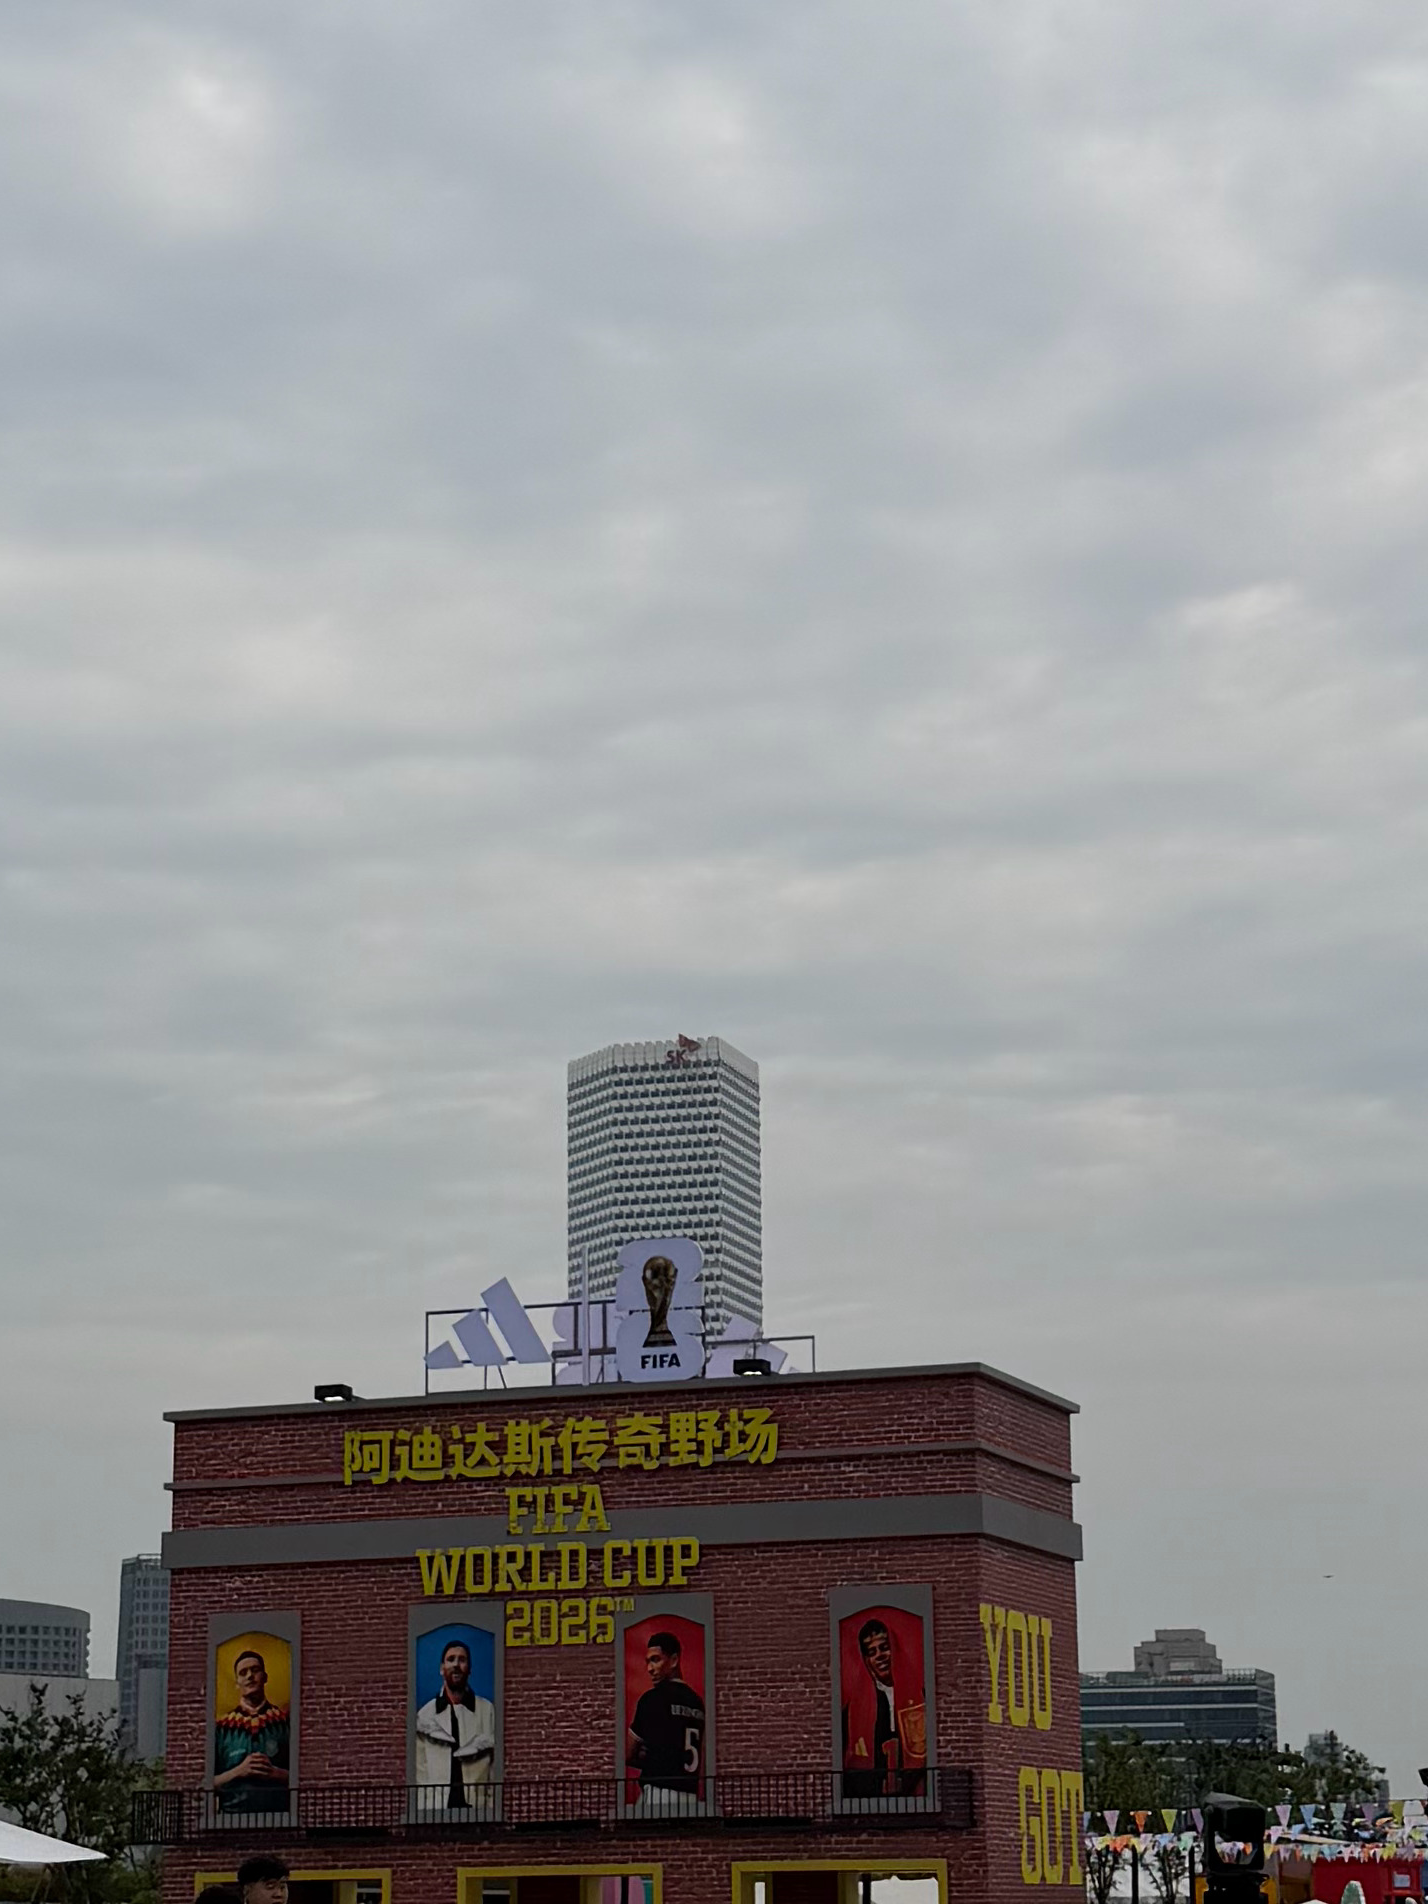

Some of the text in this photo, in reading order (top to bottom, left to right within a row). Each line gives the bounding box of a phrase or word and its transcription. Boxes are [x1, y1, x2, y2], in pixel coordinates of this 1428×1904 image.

[666, 1049, 686, 1064] SK
[640, 1353, 681, 1369] FIFA
[343, 1407, 779, 1485] 阿迪达斯传奇野场
[505, 1484, 611, 1535] FIFA
[415, 1536, 700, 1596] WORLD CUP
[979, 1603, 1052, 1731] YOU
[684, 1727, 699, 1773] 5
[1018, 1766, 1085, 1884] GOT
